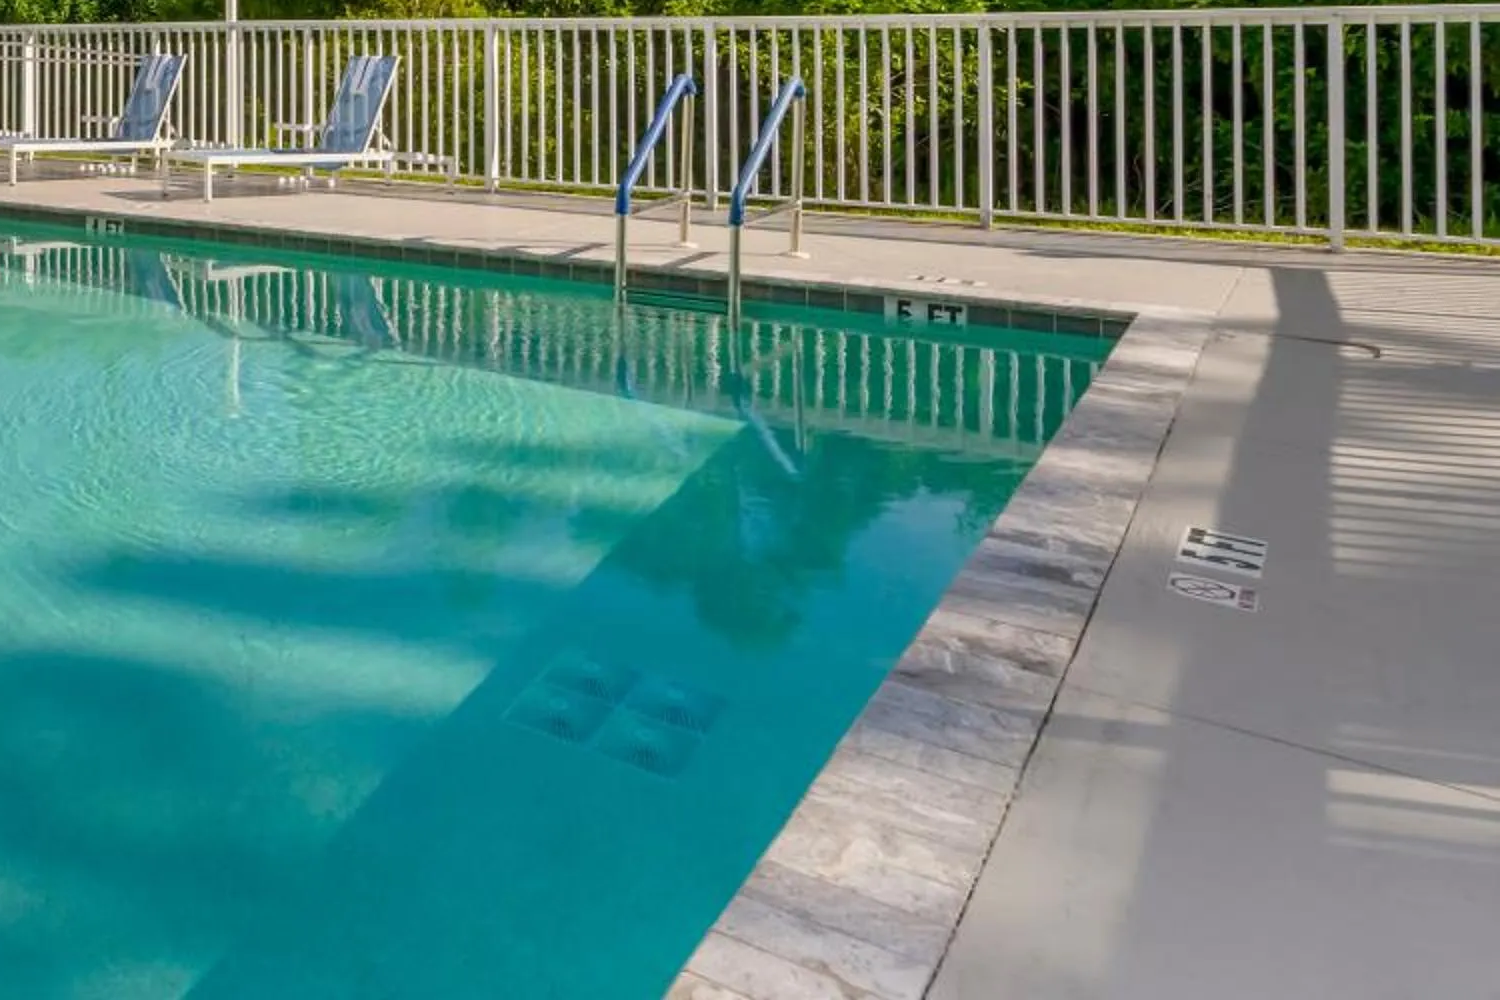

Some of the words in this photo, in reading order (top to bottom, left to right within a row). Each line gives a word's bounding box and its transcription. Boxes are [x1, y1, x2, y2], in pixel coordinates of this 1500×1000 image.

[897, 299, 912, 318] 5
[927, 303, 963, 322] FT
[1187, 527, 1266, 557] FT
[1181, 549, 1261, 570] 5
